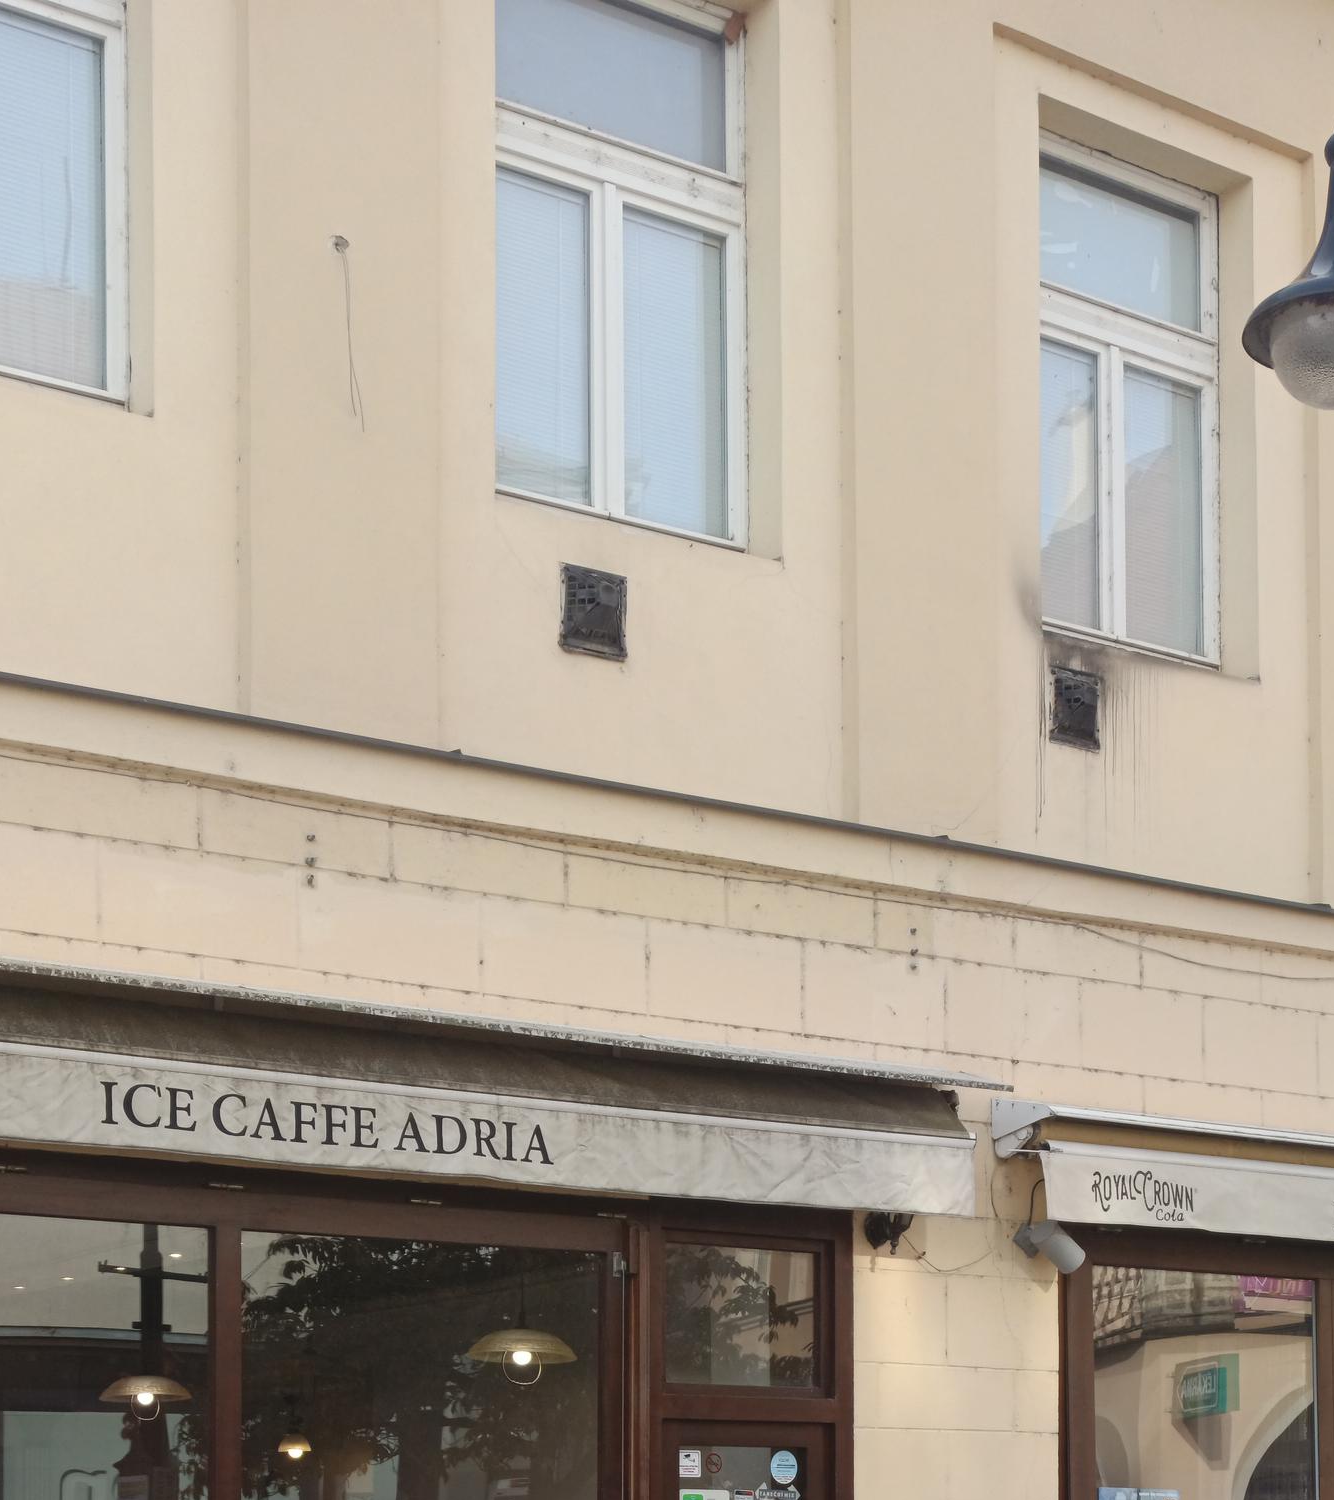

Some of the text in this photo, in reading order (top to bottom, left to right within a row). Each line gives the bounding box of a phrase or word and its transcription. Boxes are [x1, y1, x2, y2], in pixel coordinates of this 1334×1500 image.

[100, 1081, 554, 1165] ICE CAFFE ADRIA
[1155, 1209, 1184, 1221] Cola
